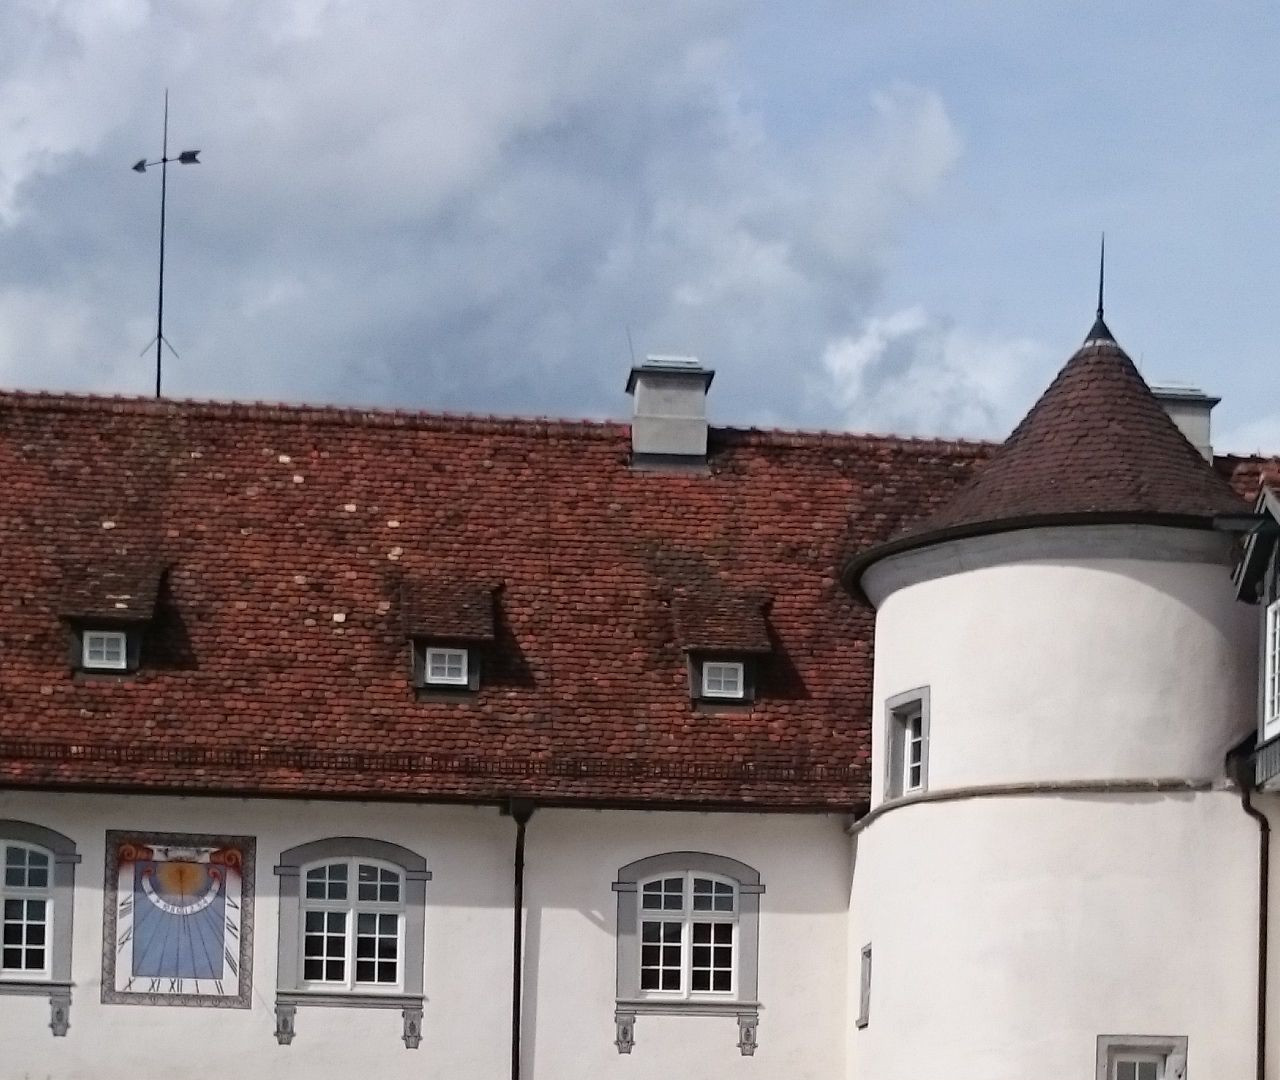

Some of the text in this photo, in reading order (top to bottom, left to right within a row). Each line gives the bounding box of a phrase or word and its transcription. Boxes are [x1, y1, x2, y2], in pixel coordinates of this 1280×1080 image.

[226, 895, 239, 909] V
[123, 977, 136, 992] X
[148, 978, 161, 993] XI
[169, 978, 183, 993] XII
[215, 980, 225, 995] II
